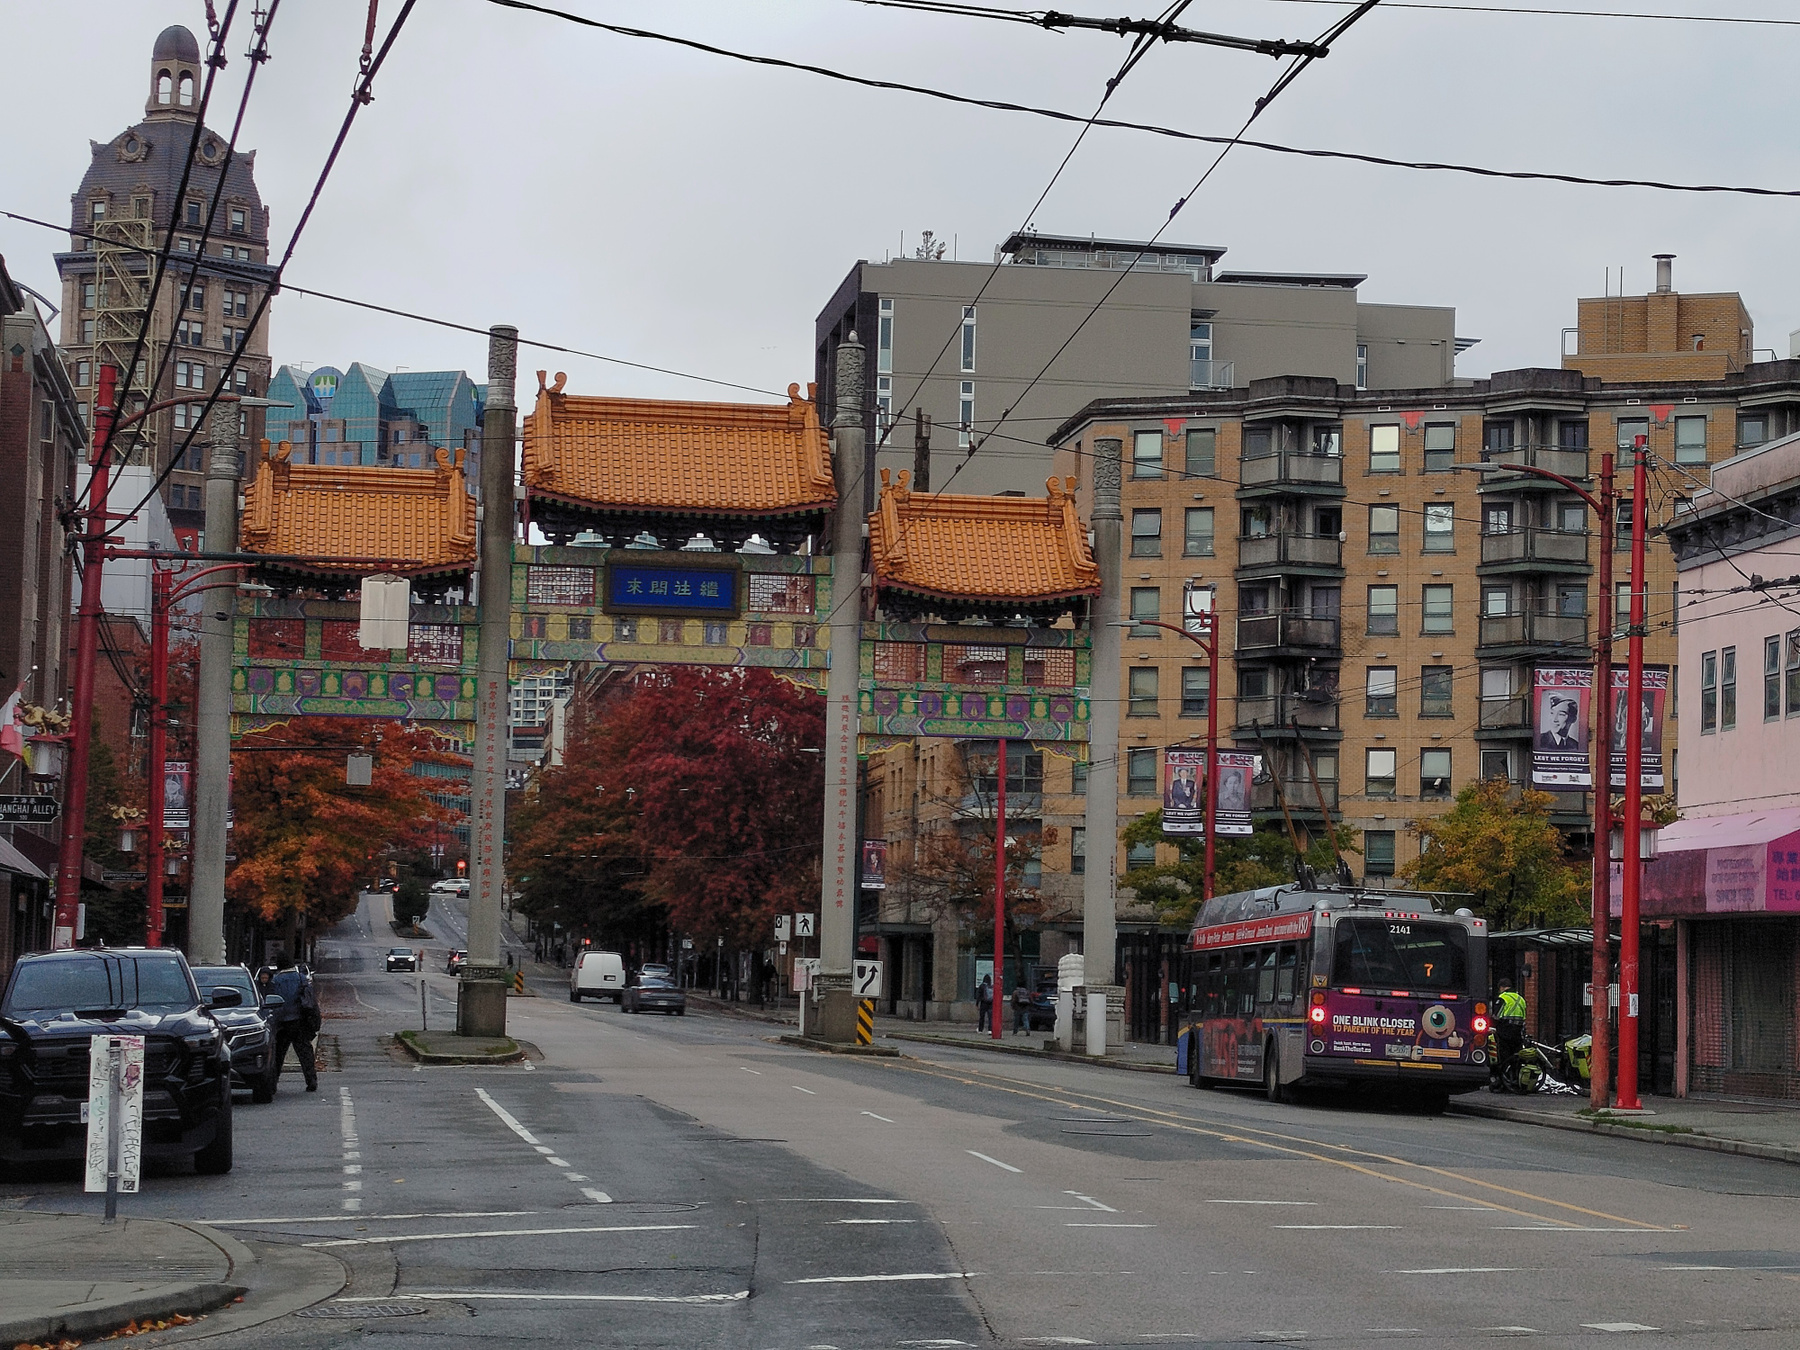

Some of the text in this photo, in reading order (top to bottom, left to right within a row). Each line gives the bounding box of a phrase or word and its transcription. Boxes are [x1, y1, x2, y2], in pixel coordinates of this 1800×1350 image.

[0, 803, 55, 814] HANGHAI ALLEY
[1390, 925, 1411, 934] 2141
[1424, 963, 1434, 977] 7
[1332, 1015, 1415, 1029] ONE BLINK CLOSER
[1333, 1024, 1342, 1032] TO
[1343, 1025, 1370, 1034] PARENT
[1382, 1027, 1396, 1035] THE
